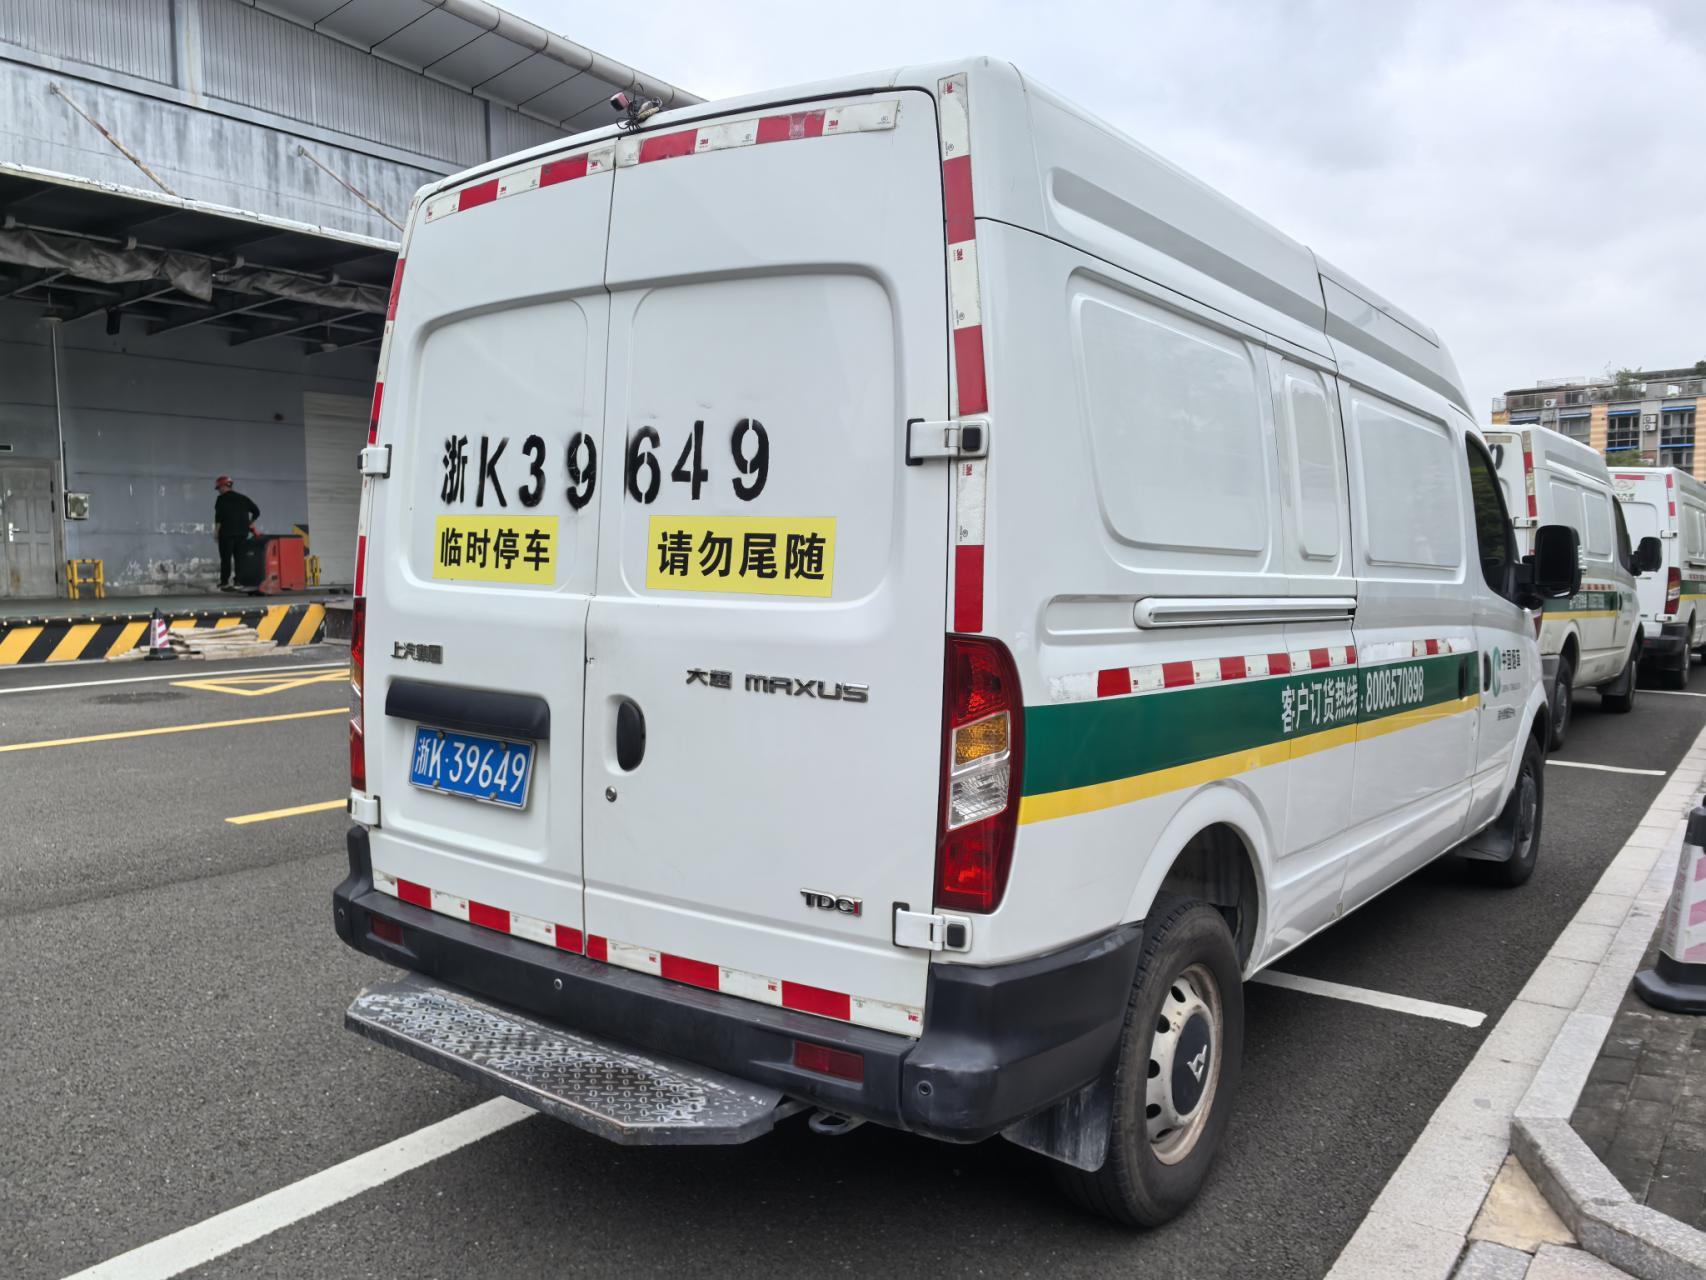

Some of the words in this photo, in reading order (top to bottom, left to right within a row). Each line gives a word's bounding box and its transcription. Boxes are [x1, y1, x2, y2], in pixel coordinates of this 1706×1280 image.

[440, 527, 551, 571] 临时停车
[657, 530, 826, 580] 请勿尾随
[745, 673, 870, 704] MAXUS
